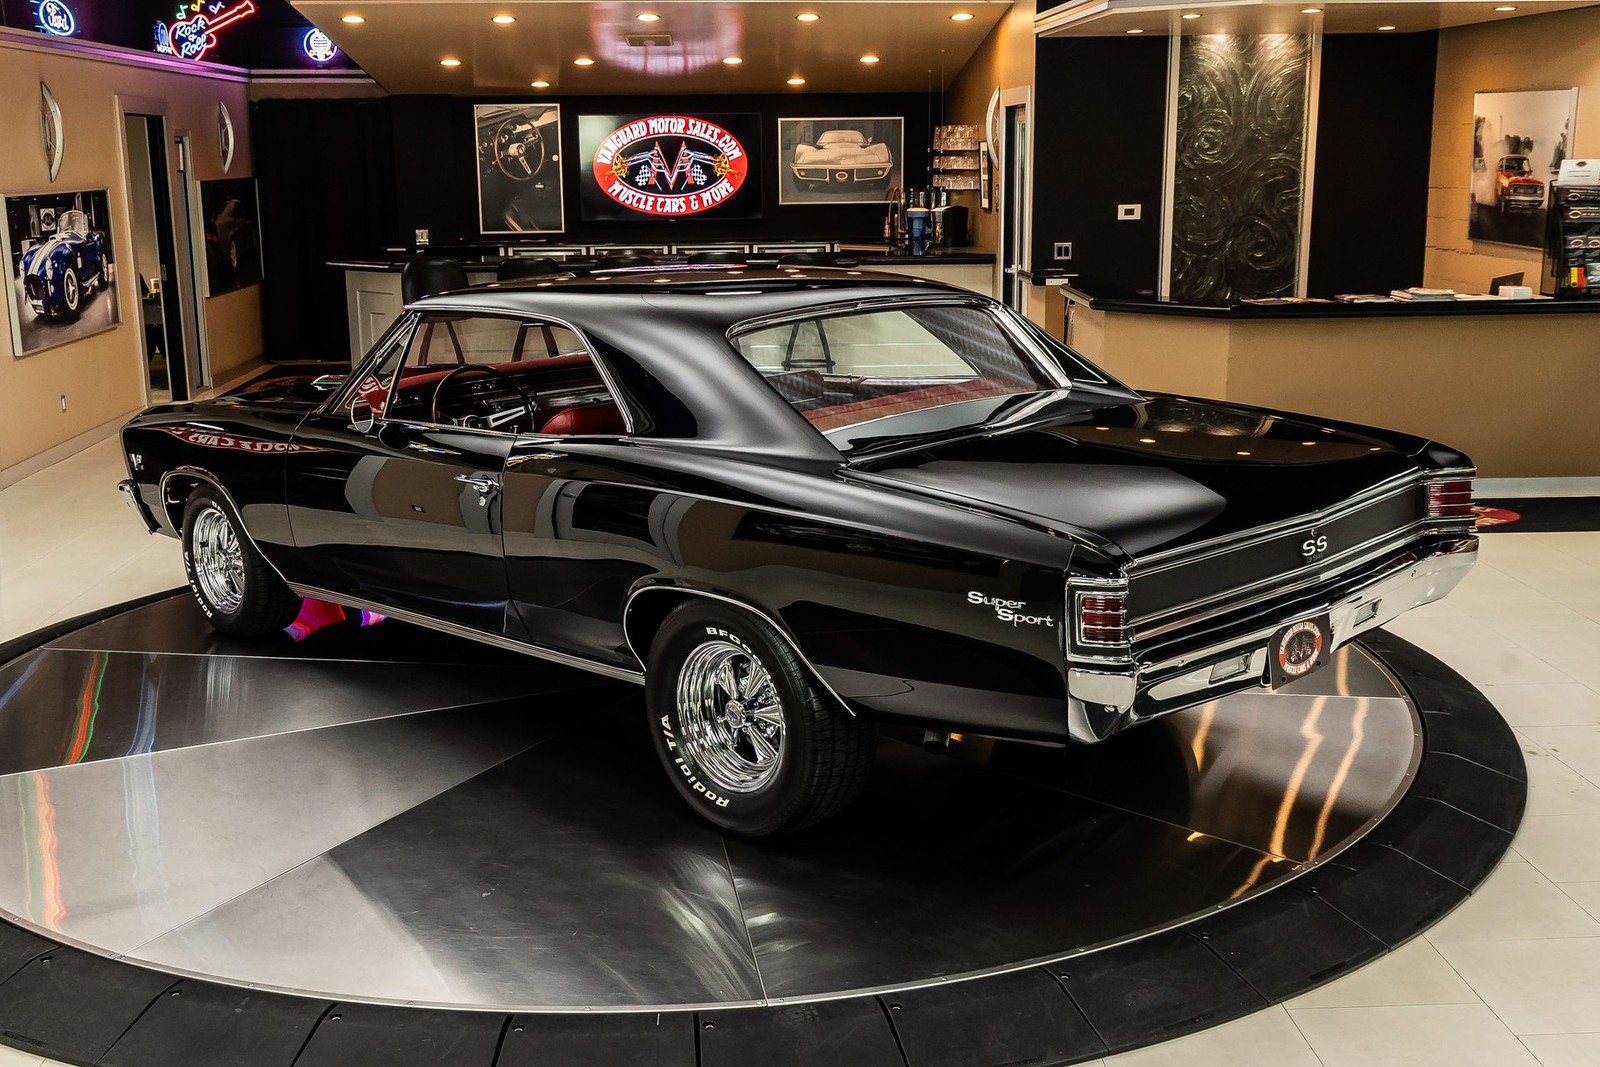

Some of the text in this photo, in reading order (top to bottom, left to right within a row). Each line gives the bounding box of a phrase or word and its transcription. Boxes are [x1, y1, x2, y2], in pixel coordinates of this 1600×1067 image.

[175, 16, 206, 39] Rock
[181, 34, 207, 58] Roll
[596, 117, 743, 165] VANGUARD MOTOR SALES.COM
[607, 178, 735, 213] MUSCLE CARS & MORE
[1302, 535, 1328, 556] SS
[967, 591, 1027, 611] Super
[997, 608, 1054, 627] Sport
[661, 714, 730, 808] Radial T/A
